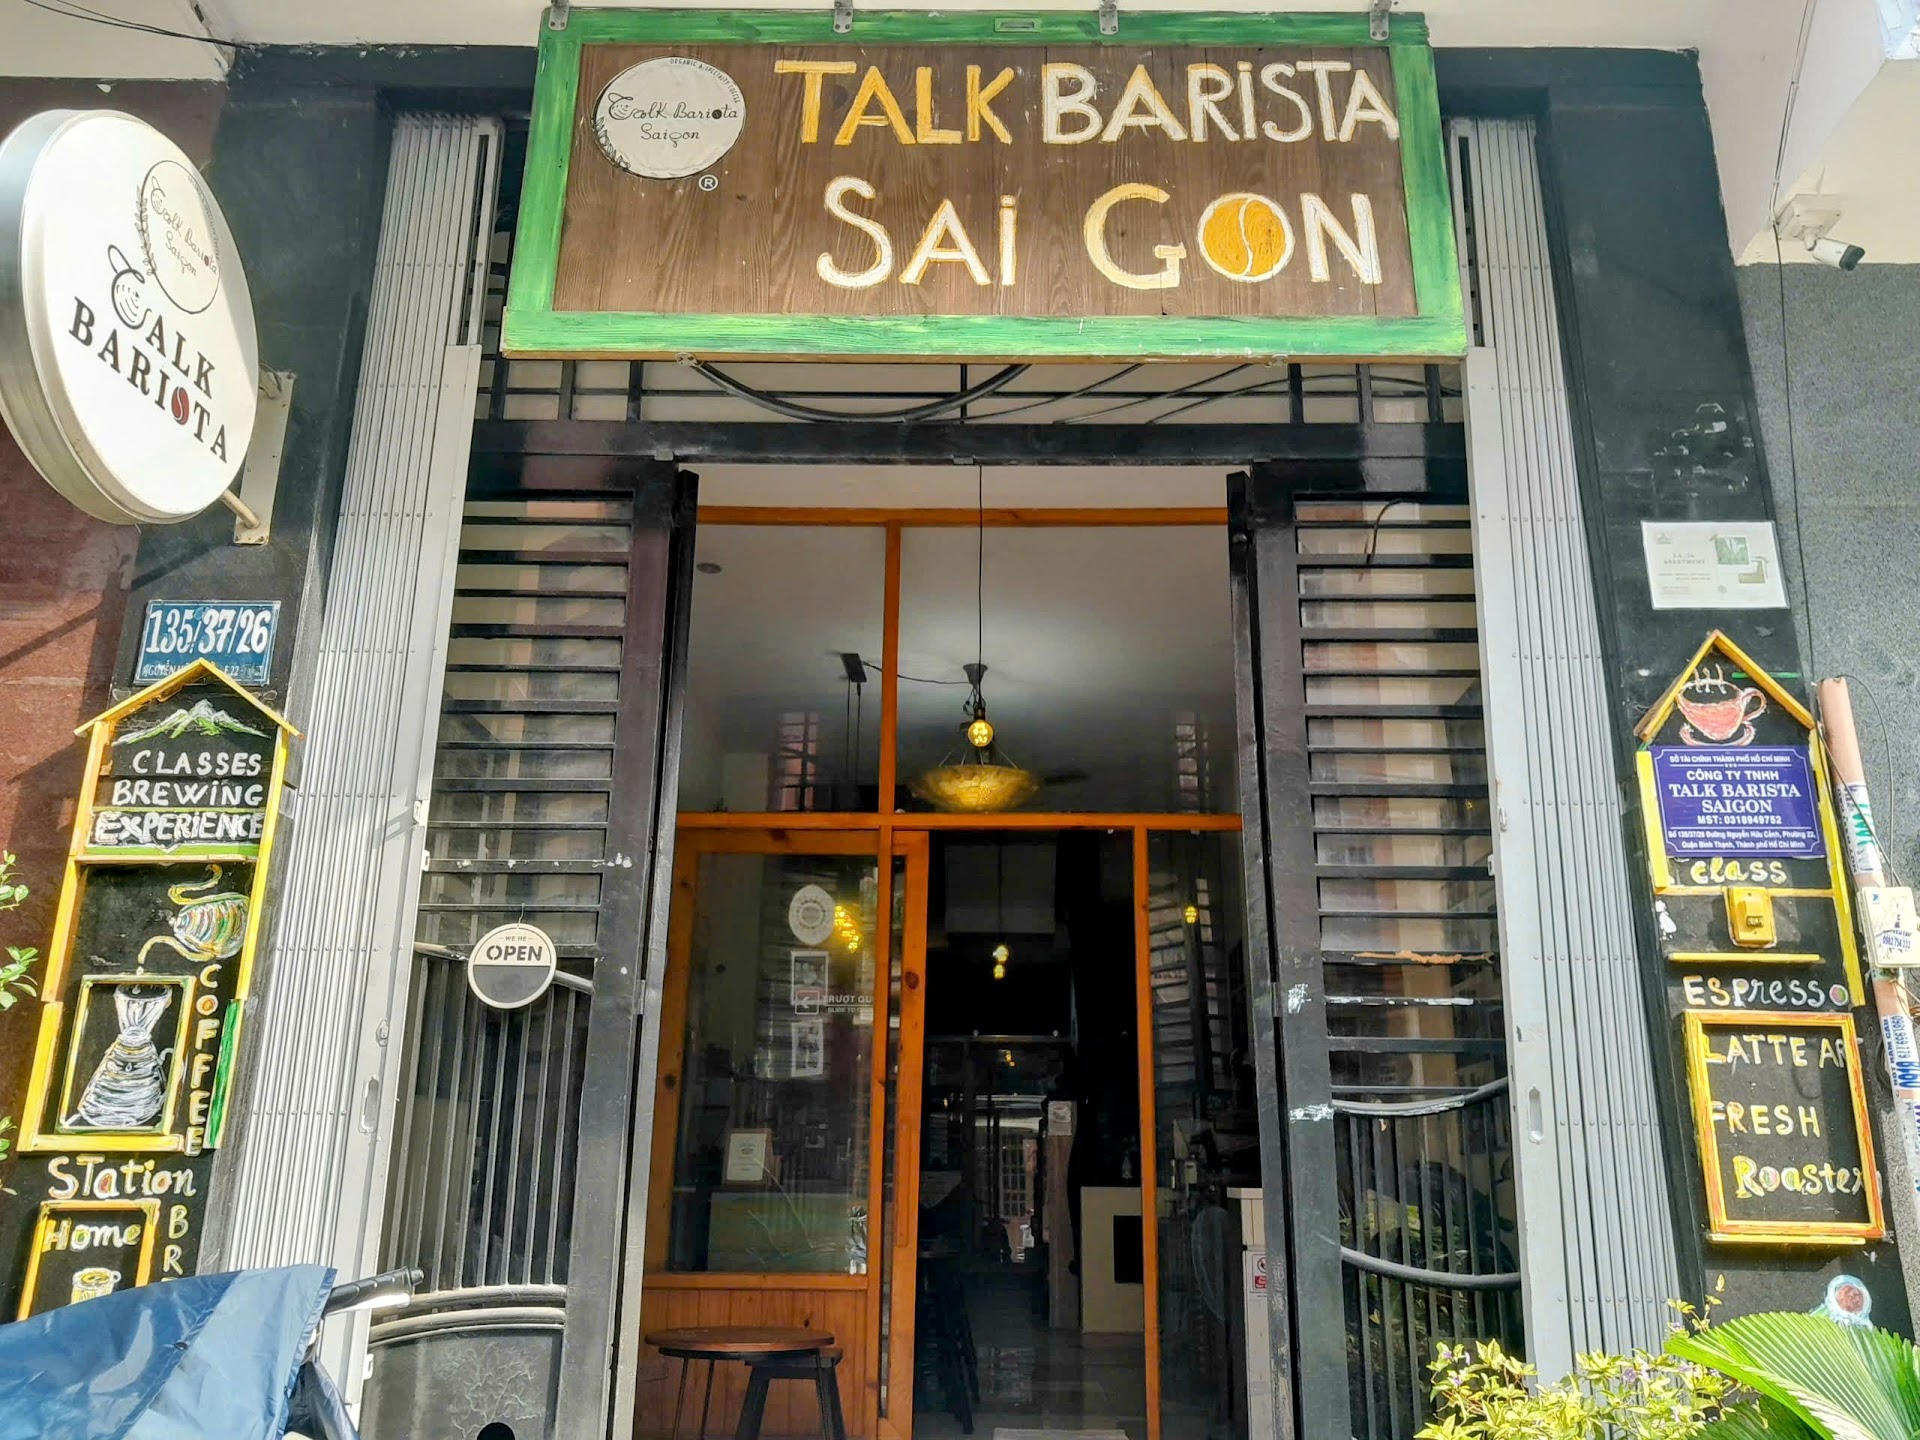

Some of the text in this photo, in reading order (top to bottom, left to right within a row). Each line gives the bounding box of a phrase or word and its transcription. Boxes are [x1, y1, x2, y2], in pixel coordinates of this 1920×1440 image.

[774, 60, 1015, 145] TALK
[640, 123, 700, 148] Saigon
[69, 296, 229, 464] BARISTA
[146, 606, 272, 654] 135/37/26
[132, 750, 263, 777] CLASSES
[1686, 768, 1779, 781] CÔNG TY TNHH
[1669, 783, 1801, 798] TALK BARISTA
[1702, 799, 1773, 813] SAIGON
[1697, 815, 1782, 825] MST: 0318949752
[486, 945, 543, 961] OPEN
[184, 963, 223, 1157] COFFEE
[1702, 1033, 1808, 1067] LATTE
[42, 1216, 142, 1253] Home
